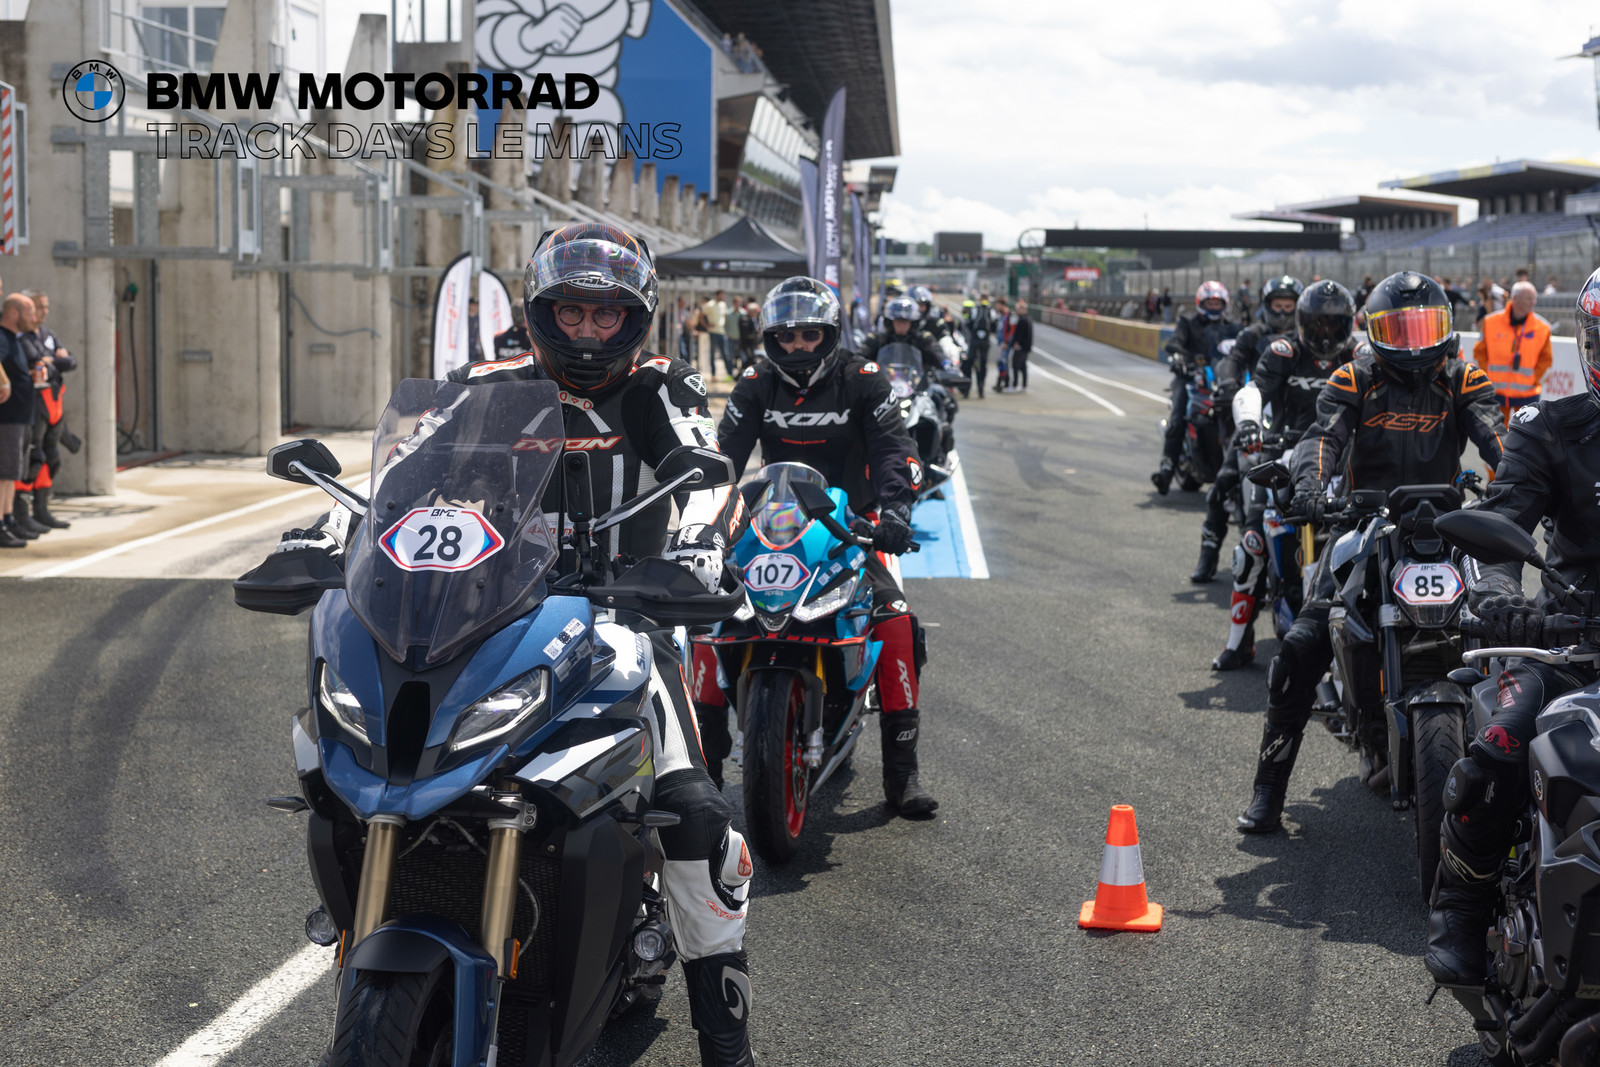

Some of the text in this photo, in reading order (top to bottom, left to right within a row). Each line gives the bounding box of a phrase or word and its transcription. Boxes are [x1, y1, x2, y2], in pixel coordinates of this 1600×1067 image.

[413, 524, 462, 562] 28
[755, 563, 793, 585] 107
[1415, 575, 1445, 597] 85
